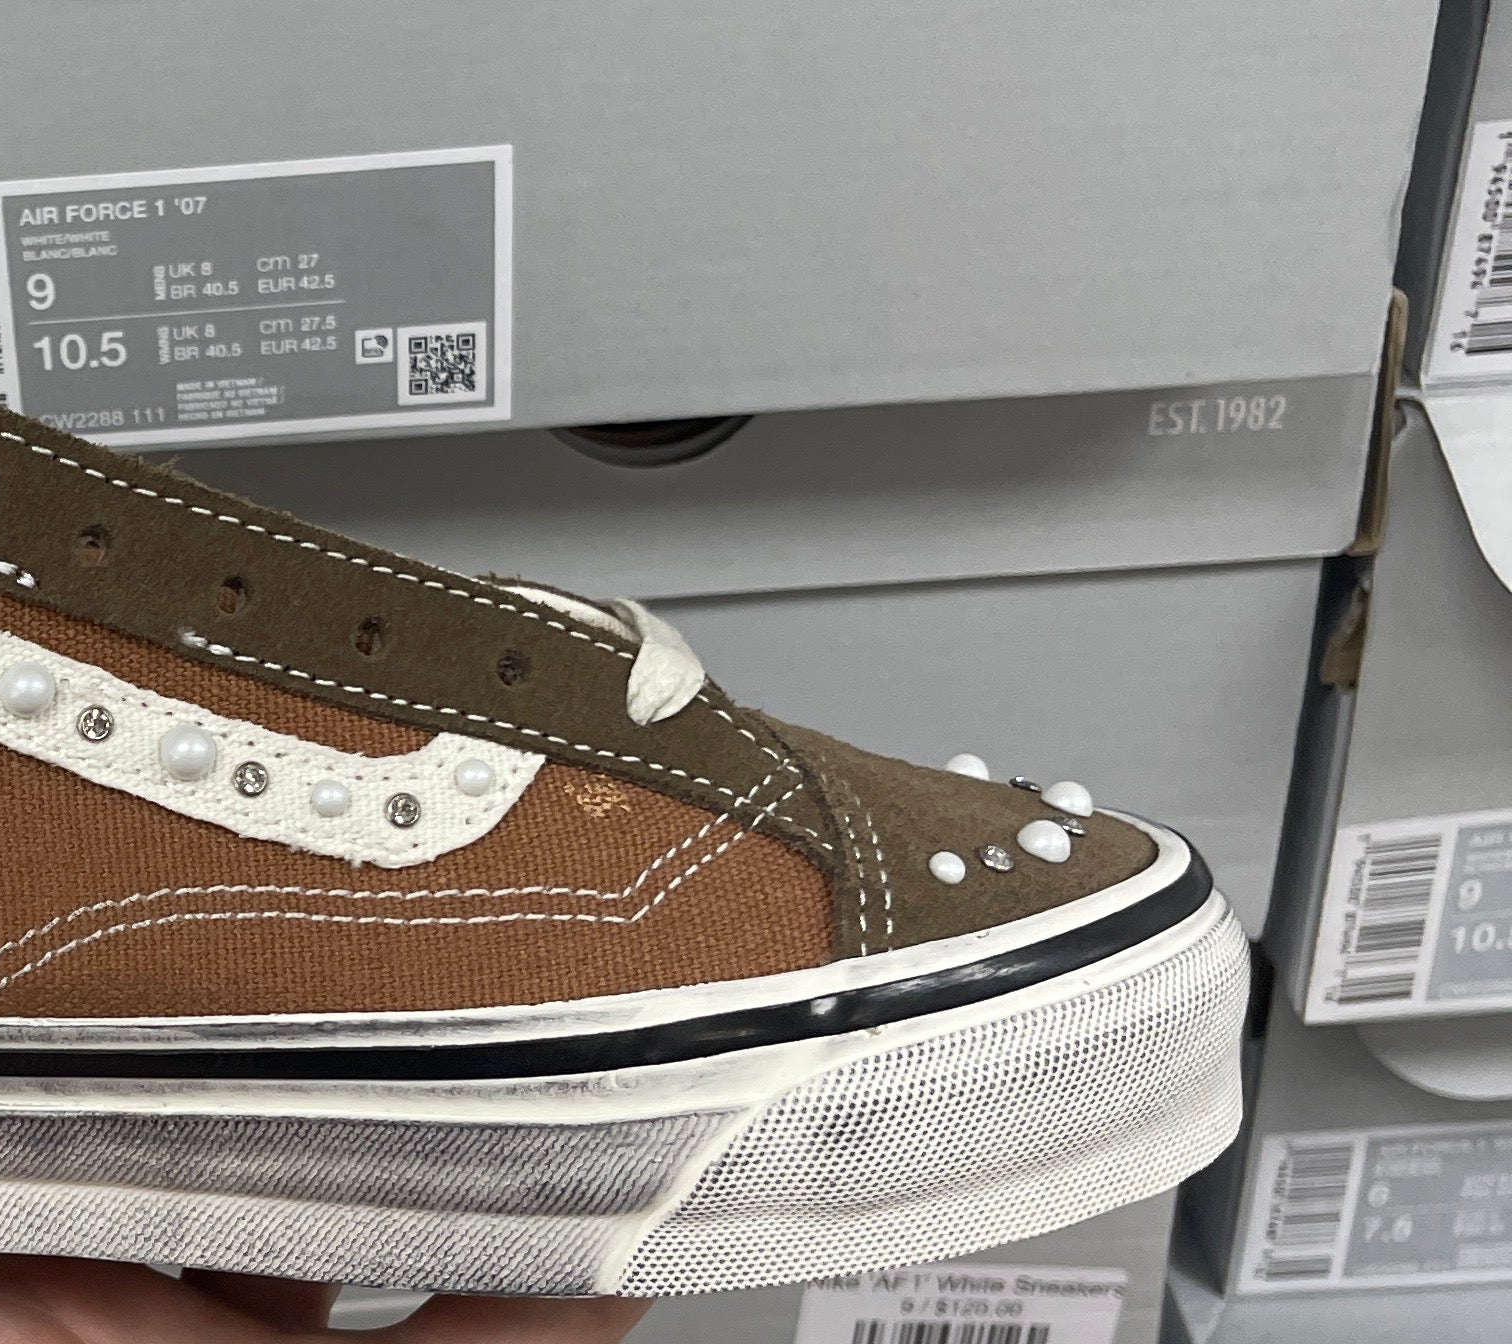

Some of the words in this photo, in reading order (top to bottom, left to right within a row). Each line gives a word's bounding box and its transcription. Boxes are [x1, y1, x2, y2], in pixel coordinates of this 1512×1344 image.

[19, 206, 60, 227] AIR
[65, 200, 148, 223] FORCE
[155, 200, 165, 216] 1
[174, 196, 207, 215] '07
[20, 230, 111, 247] WHITE/WHITE
[169, 262, 196, 278] UK
[201, 261, 213, 276] 8
[298, 253, 319, 269] 27
[26, 273, 55, 311] 9
[170, 285, 197, 300] BR
[202, 281, 239, 296] 40.5
[258, 276, 295, 294] EUR
[299, 274, 335, 289] 42.5
[173, 325, 199, 341] UK
[204, 324, 215, 338] 8
[300, 315, 336, 332] 27.5
[33, 331, 127, 371] 10.5
[174, 346, 199, 361] BR
[205, 343, 241, 358] 40.5
[261, 339, 298, 356] EUR
[301, 336, 337, 351] 42.5
[1449, 922, 1512, 955] 10.
[937, 1274, 1005, 1294] White
[1014, 1274, 1125, 1298] Sneakers
